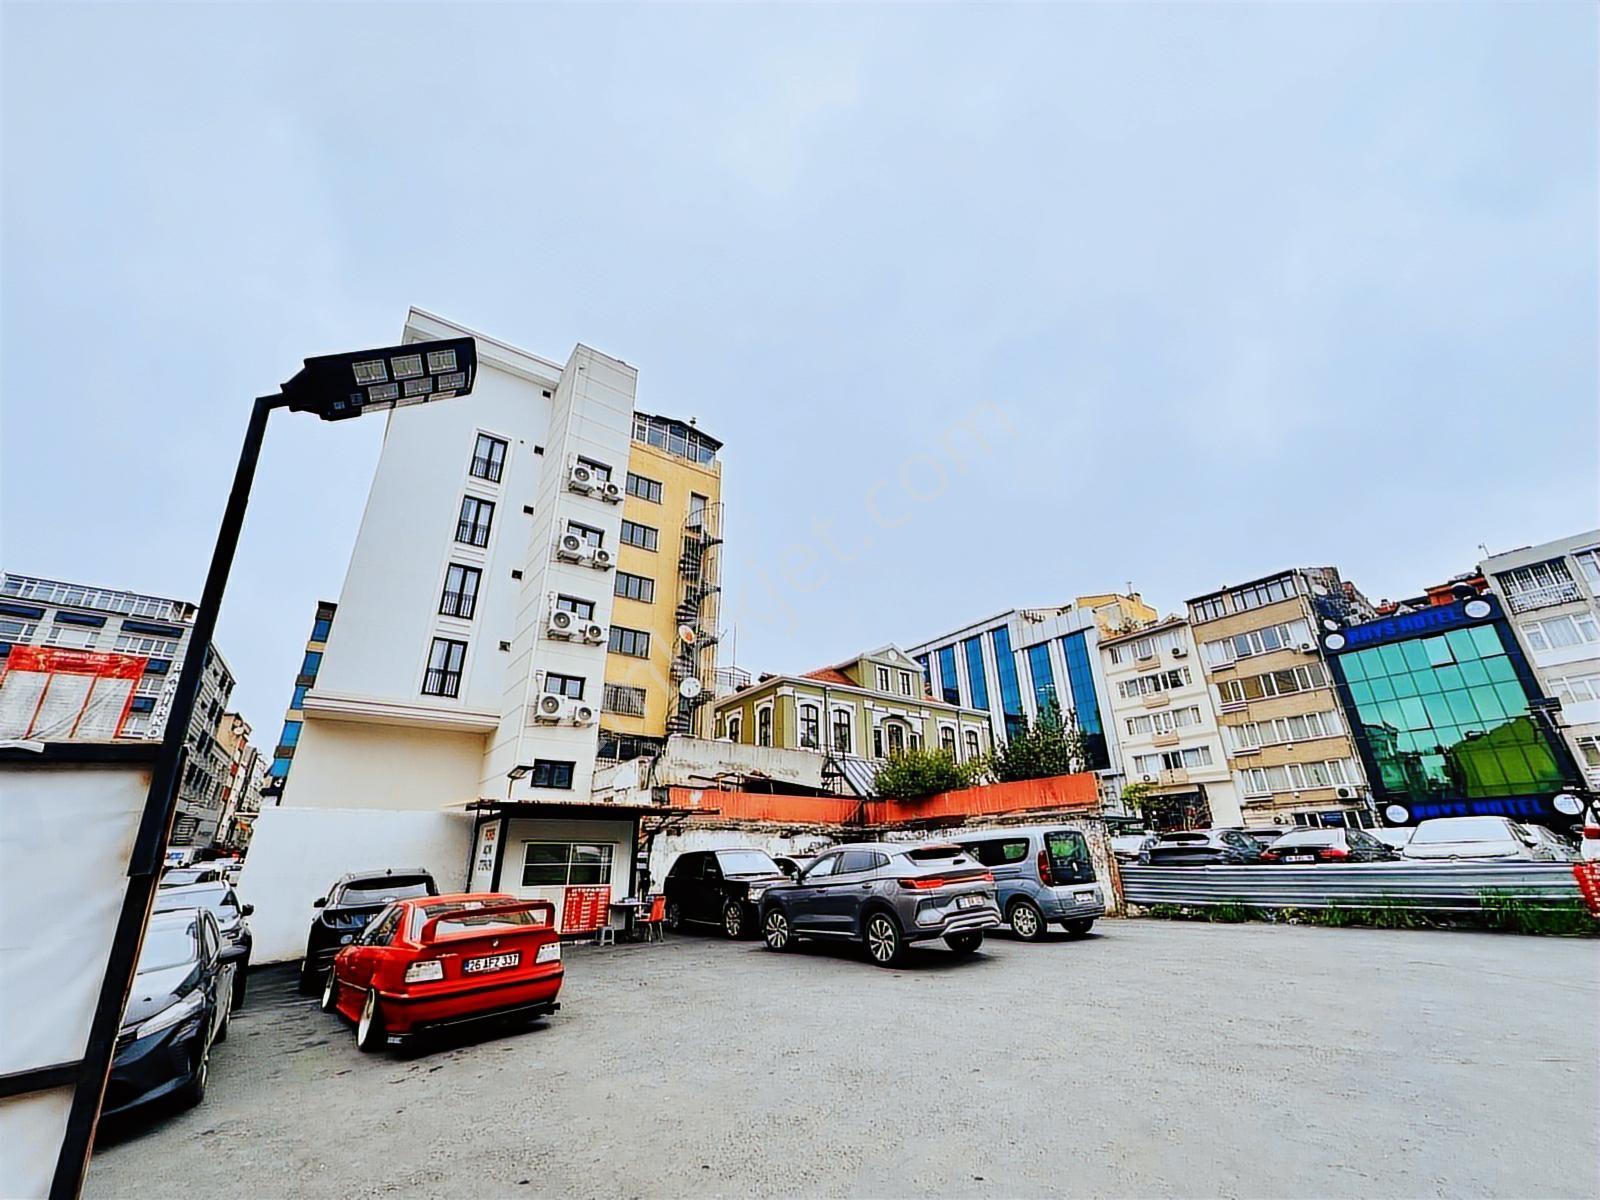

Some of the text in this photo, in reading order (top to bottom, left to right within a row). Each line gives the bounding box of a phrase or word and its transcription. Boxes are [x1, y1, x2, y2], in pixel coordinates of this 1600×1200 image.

[1399, 607, 1459, 633] HOTEL
[1472, 799, 1543, 816] HOTEL
[469, 959, 481, 970] 26
[501, 954, 518, 966] 337
